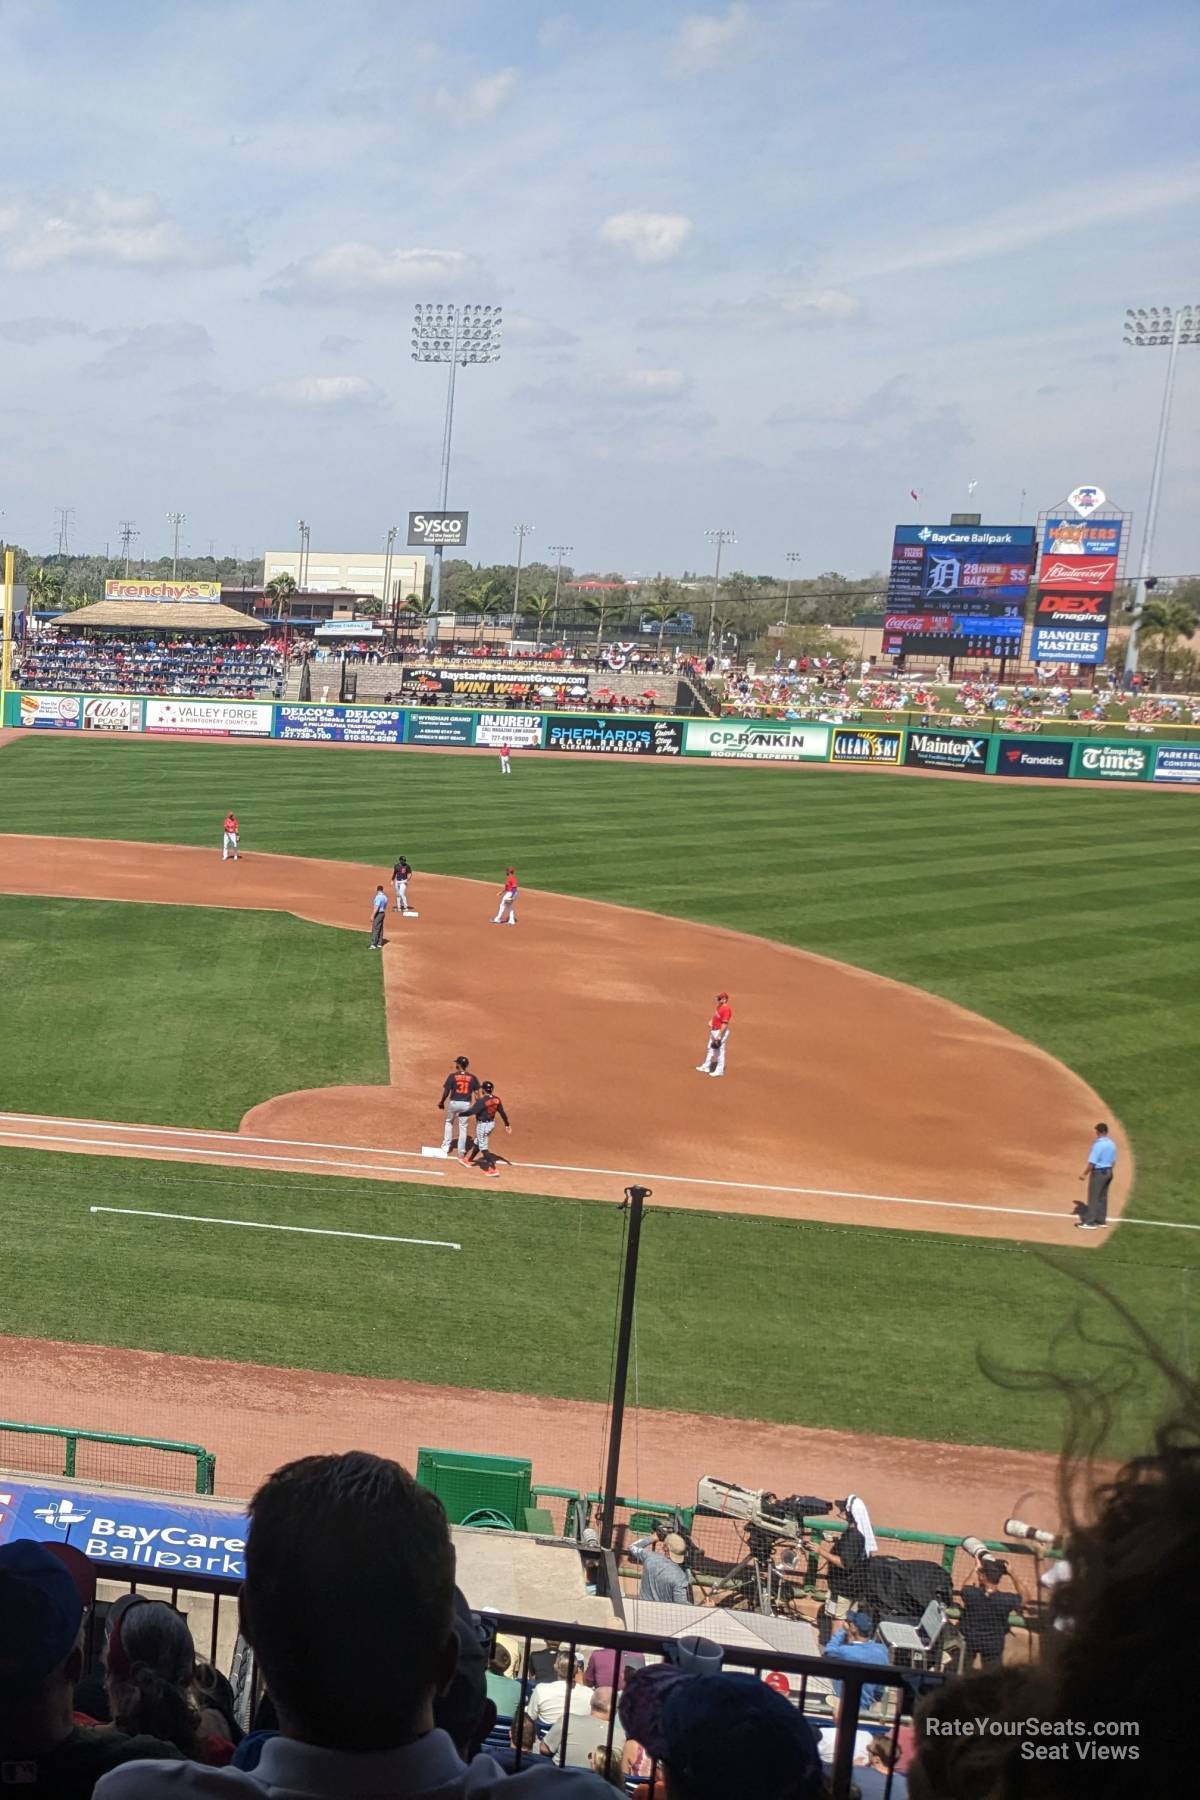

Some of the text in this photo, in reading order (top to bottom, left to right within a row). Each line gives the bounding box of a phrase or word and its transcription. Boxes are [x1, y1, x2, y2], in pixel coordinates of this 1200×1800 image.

[413, 515, 461, 536] Sysco
[932, 533, 1012, 544] BayCare Ballpark
[963, 563, 978, 575] 28
[1010, 569, 1027, 581] SS
[1049, 567, 1105, 578] Budweiser
[107, 581, 199, 599] Frenchy's
[1038, 596, 1103, 613] DEX
[1052, 612, 1107, 622] imaging
[1038, 630, 1100, 642] BANQUET
[1037, 641, 1098, 652] MASTERS
[440, 671, 586, 684] BaystarRestaurantGroup.com
[454, 681, 491, 693] WIN!
[178, 706, 258, 718] VALLEY FORGE
[281, 706, 400, 720] DELCO'S DELCO'S
[362, 718, 392, 726] Hoagies
[480, 714, 541, 728] INJURED?
[551, 728, 651, 742] SHEPHARD'S
[710, 732, 805, 748] CP-RANKIN
[550, 738, 650, 749] BEACH RESORT
[834, 736, 899, 757] CLEAR SKY
[911, 734, 984, 761] MaintenX
[1103, 747, 1143, 758] Tampa Bay
[1020, 754, 1064, 766] Fanatics
[1082, 748, 1145, 770] Times
[456, 1082, 469, 1094] 31
[91, 1516, 245, 1553] BayCare
[85, 1538, 241, 1575] Ballpark
